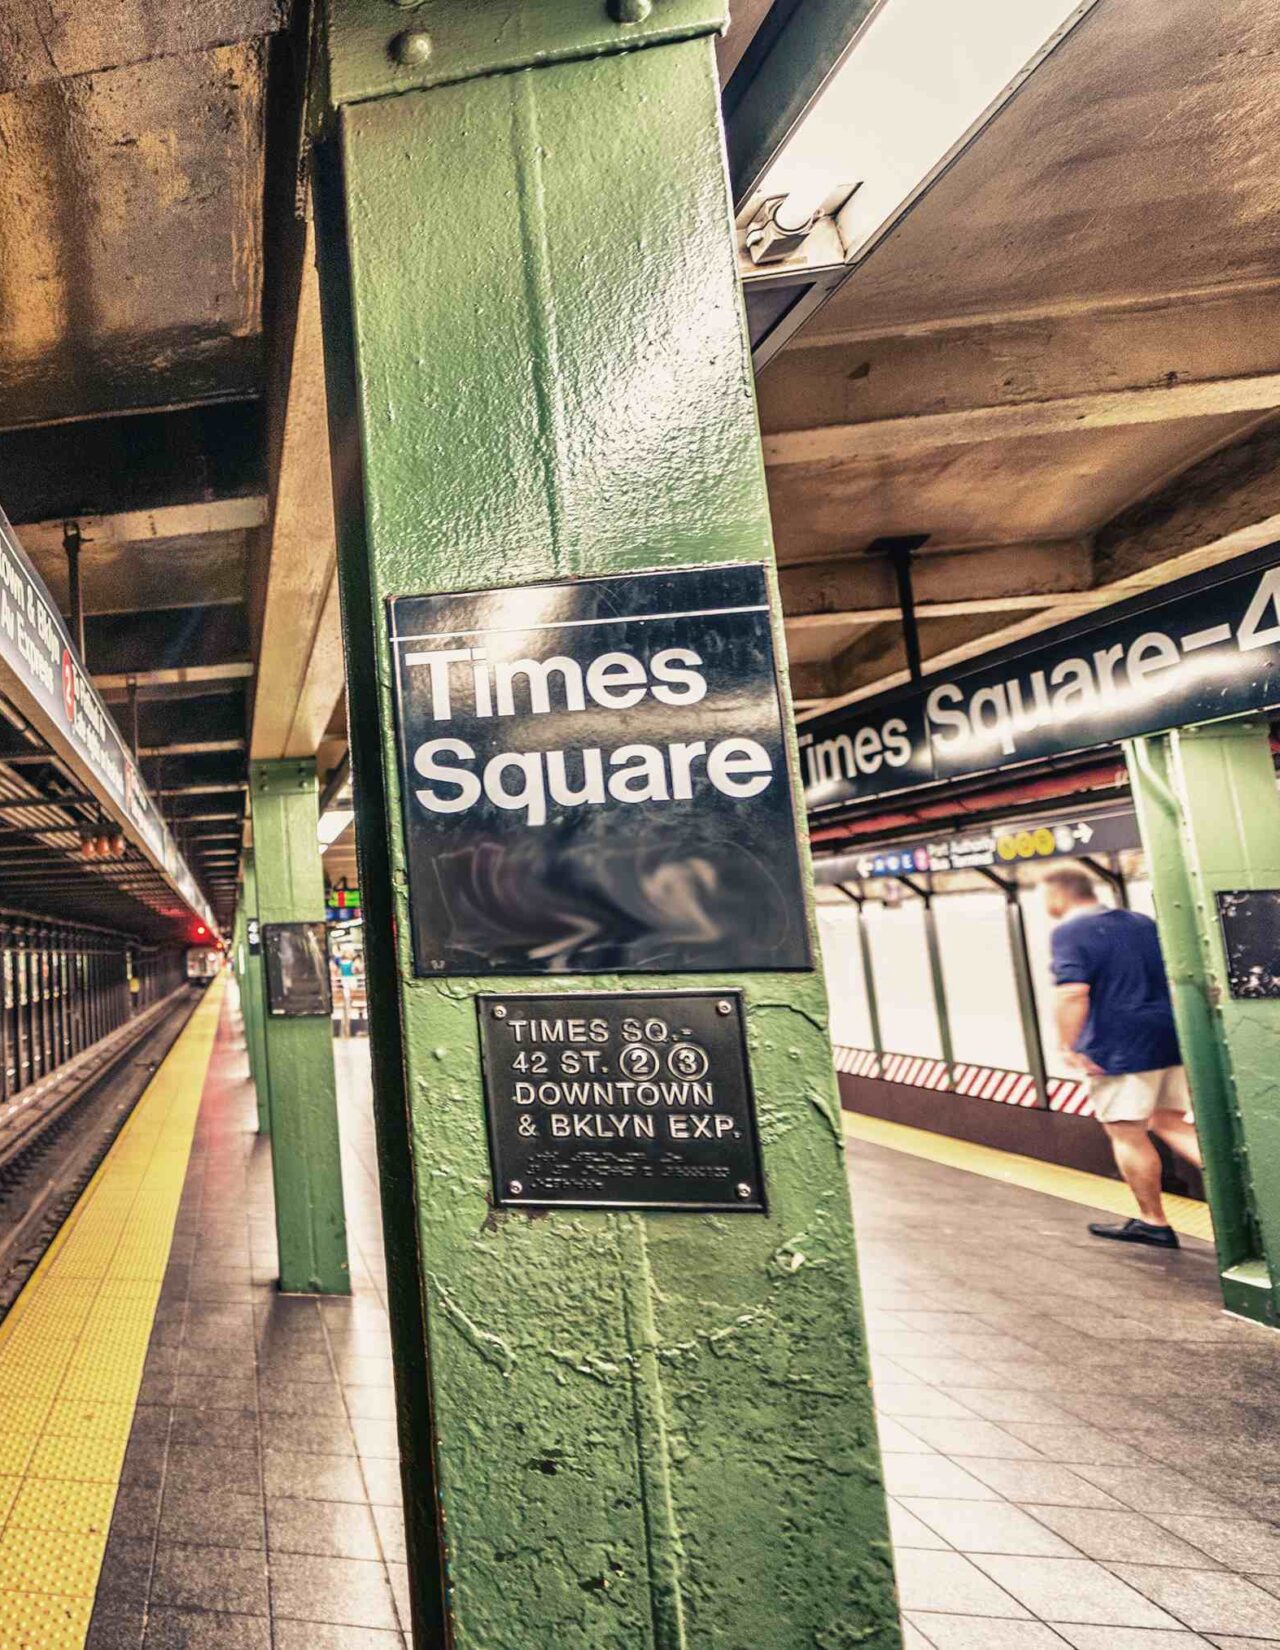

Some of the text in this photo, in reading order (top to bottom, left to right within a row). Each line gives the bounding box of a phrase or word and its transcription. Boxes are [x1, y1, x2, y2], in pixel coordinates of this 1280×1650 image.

[26, 585, 36, 628] &
[1, 589, 14, 639] Av
[17, 611, 55, 695] Express
[405, 646, 708, 721] Times
[413, 736, 773, 827] Square
[508, 1018, 610, 1043] TIMES
[512, 1050, 698, 1074] 42 ST. 2 3
[515, 1081, 714, 1106] DOWNTOWN
[518, 1113, 741, 1139] & BKLYN EXP.
